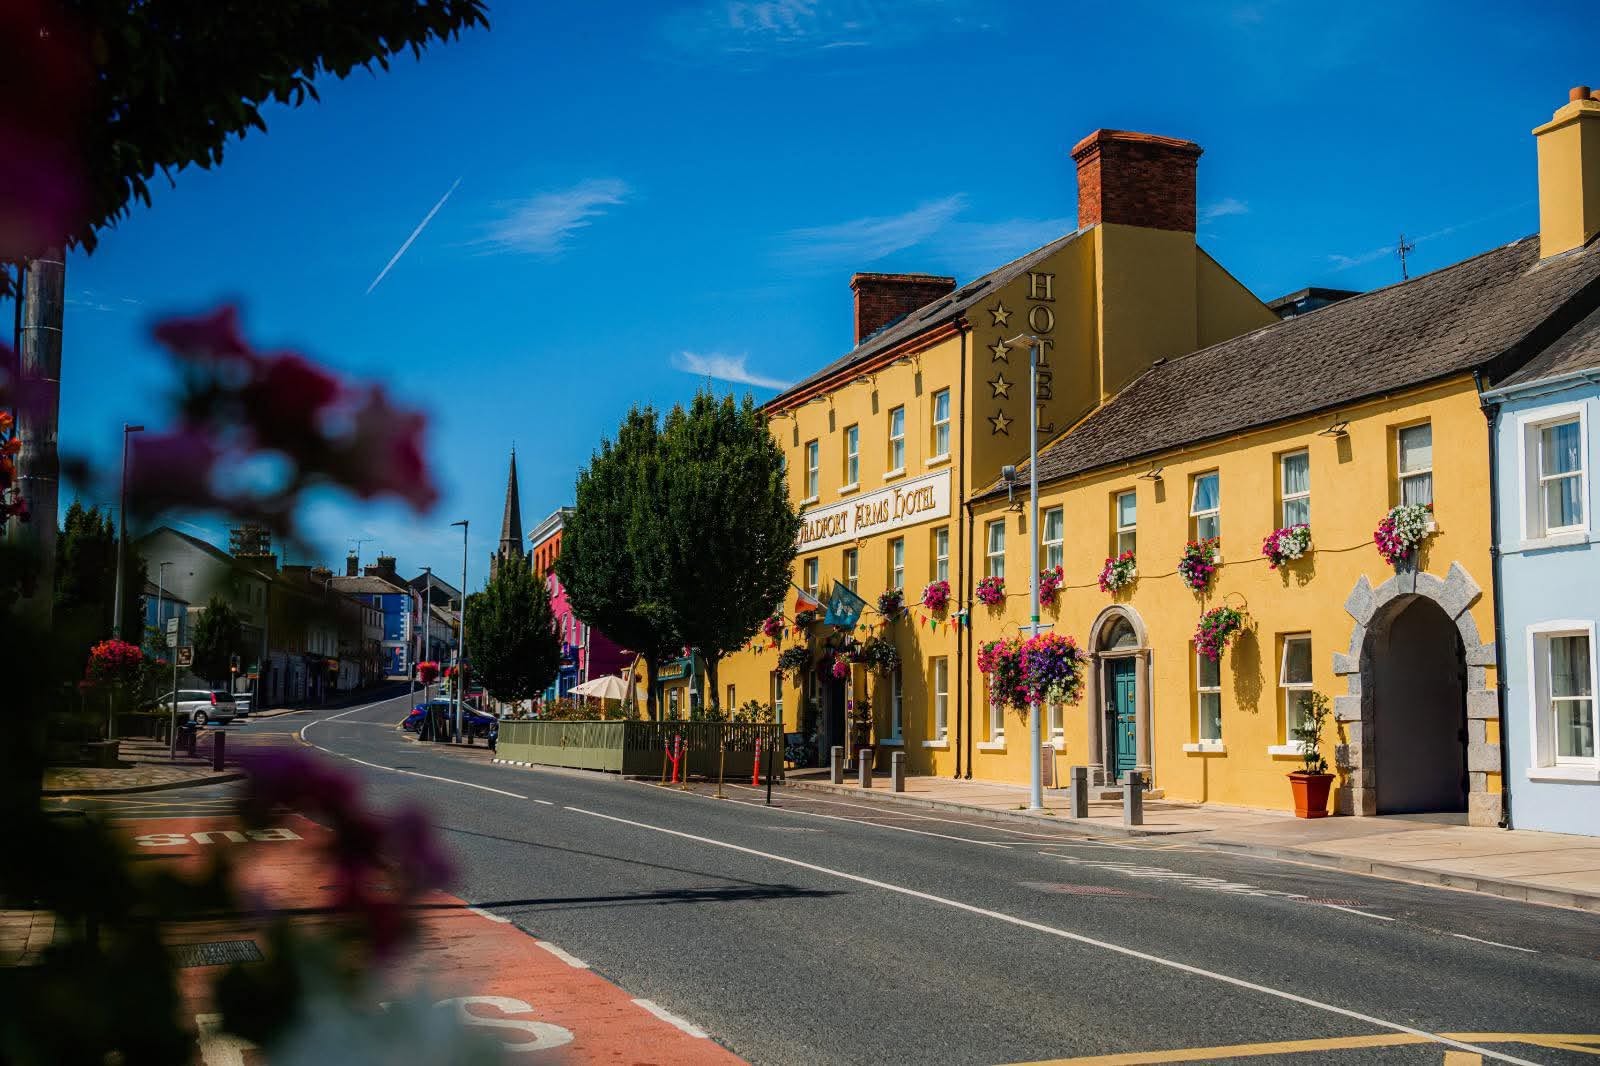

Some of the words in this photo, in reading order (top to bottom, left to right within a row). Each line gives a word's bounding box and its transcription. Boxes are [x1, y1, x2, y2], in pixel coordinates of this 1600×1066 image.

[1026, 272, 1056, 433] HOTEL
[854, 499, 889, 533] ARMS
[892, 485, 935, 521] HOTEL
[134, 828, 304, 847] BUS
